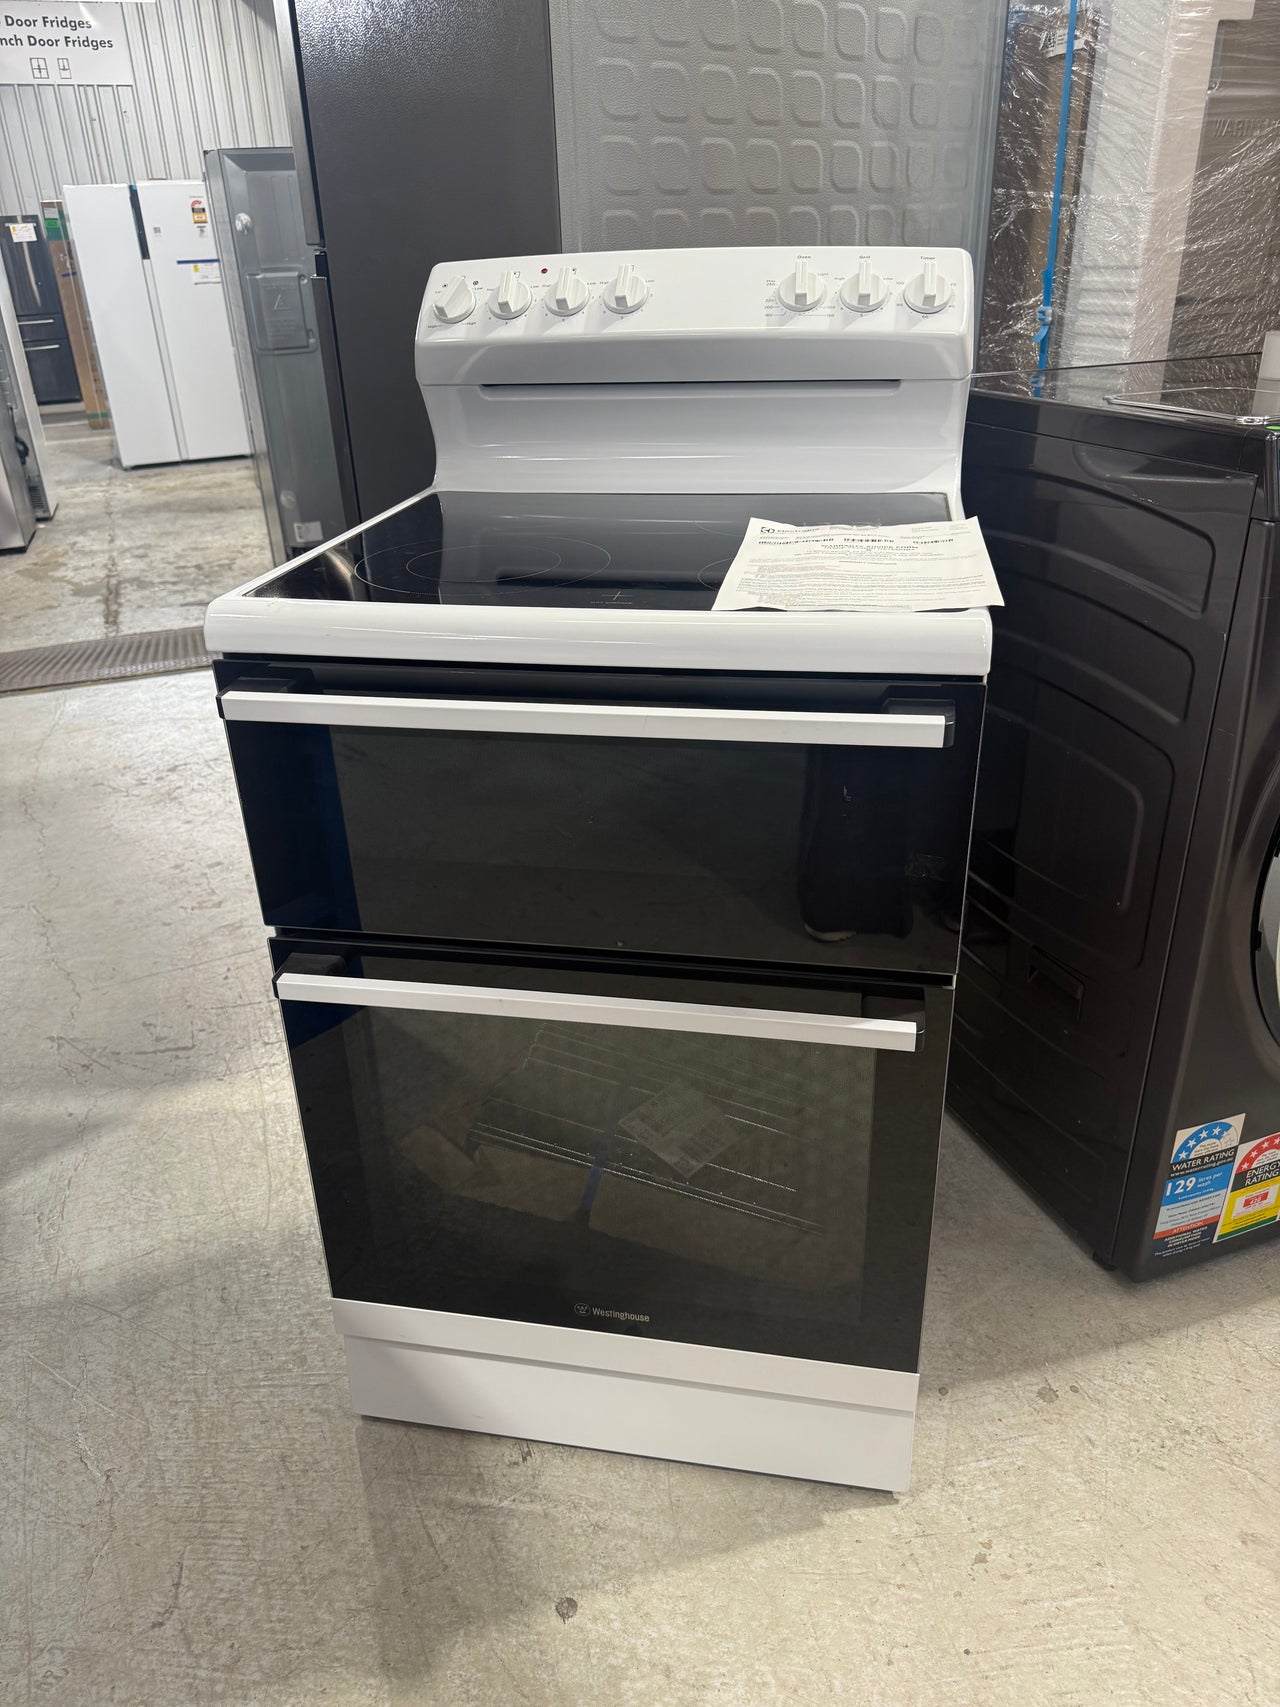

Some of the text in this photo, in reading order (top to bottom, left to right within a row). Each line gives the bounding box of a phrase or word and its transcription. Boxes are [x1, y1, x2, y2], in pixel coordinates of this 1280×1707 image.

[4, 15, 92, 31] Door Fridges
[27, 35, 60, 48] Door
[64, 36, 114, 51] Fridges
[1172, 1158, 1202, 1172] WATER
[1203, 1149, 1235, 1164] RATING
[1245, 1169, 1279, 1187] RATING
[1246, 1161, 1280, 1179] ENERGY
[1165, 1177, 1196, 1197] 129
[592, 1307, 650, 1322] Westinghouse
